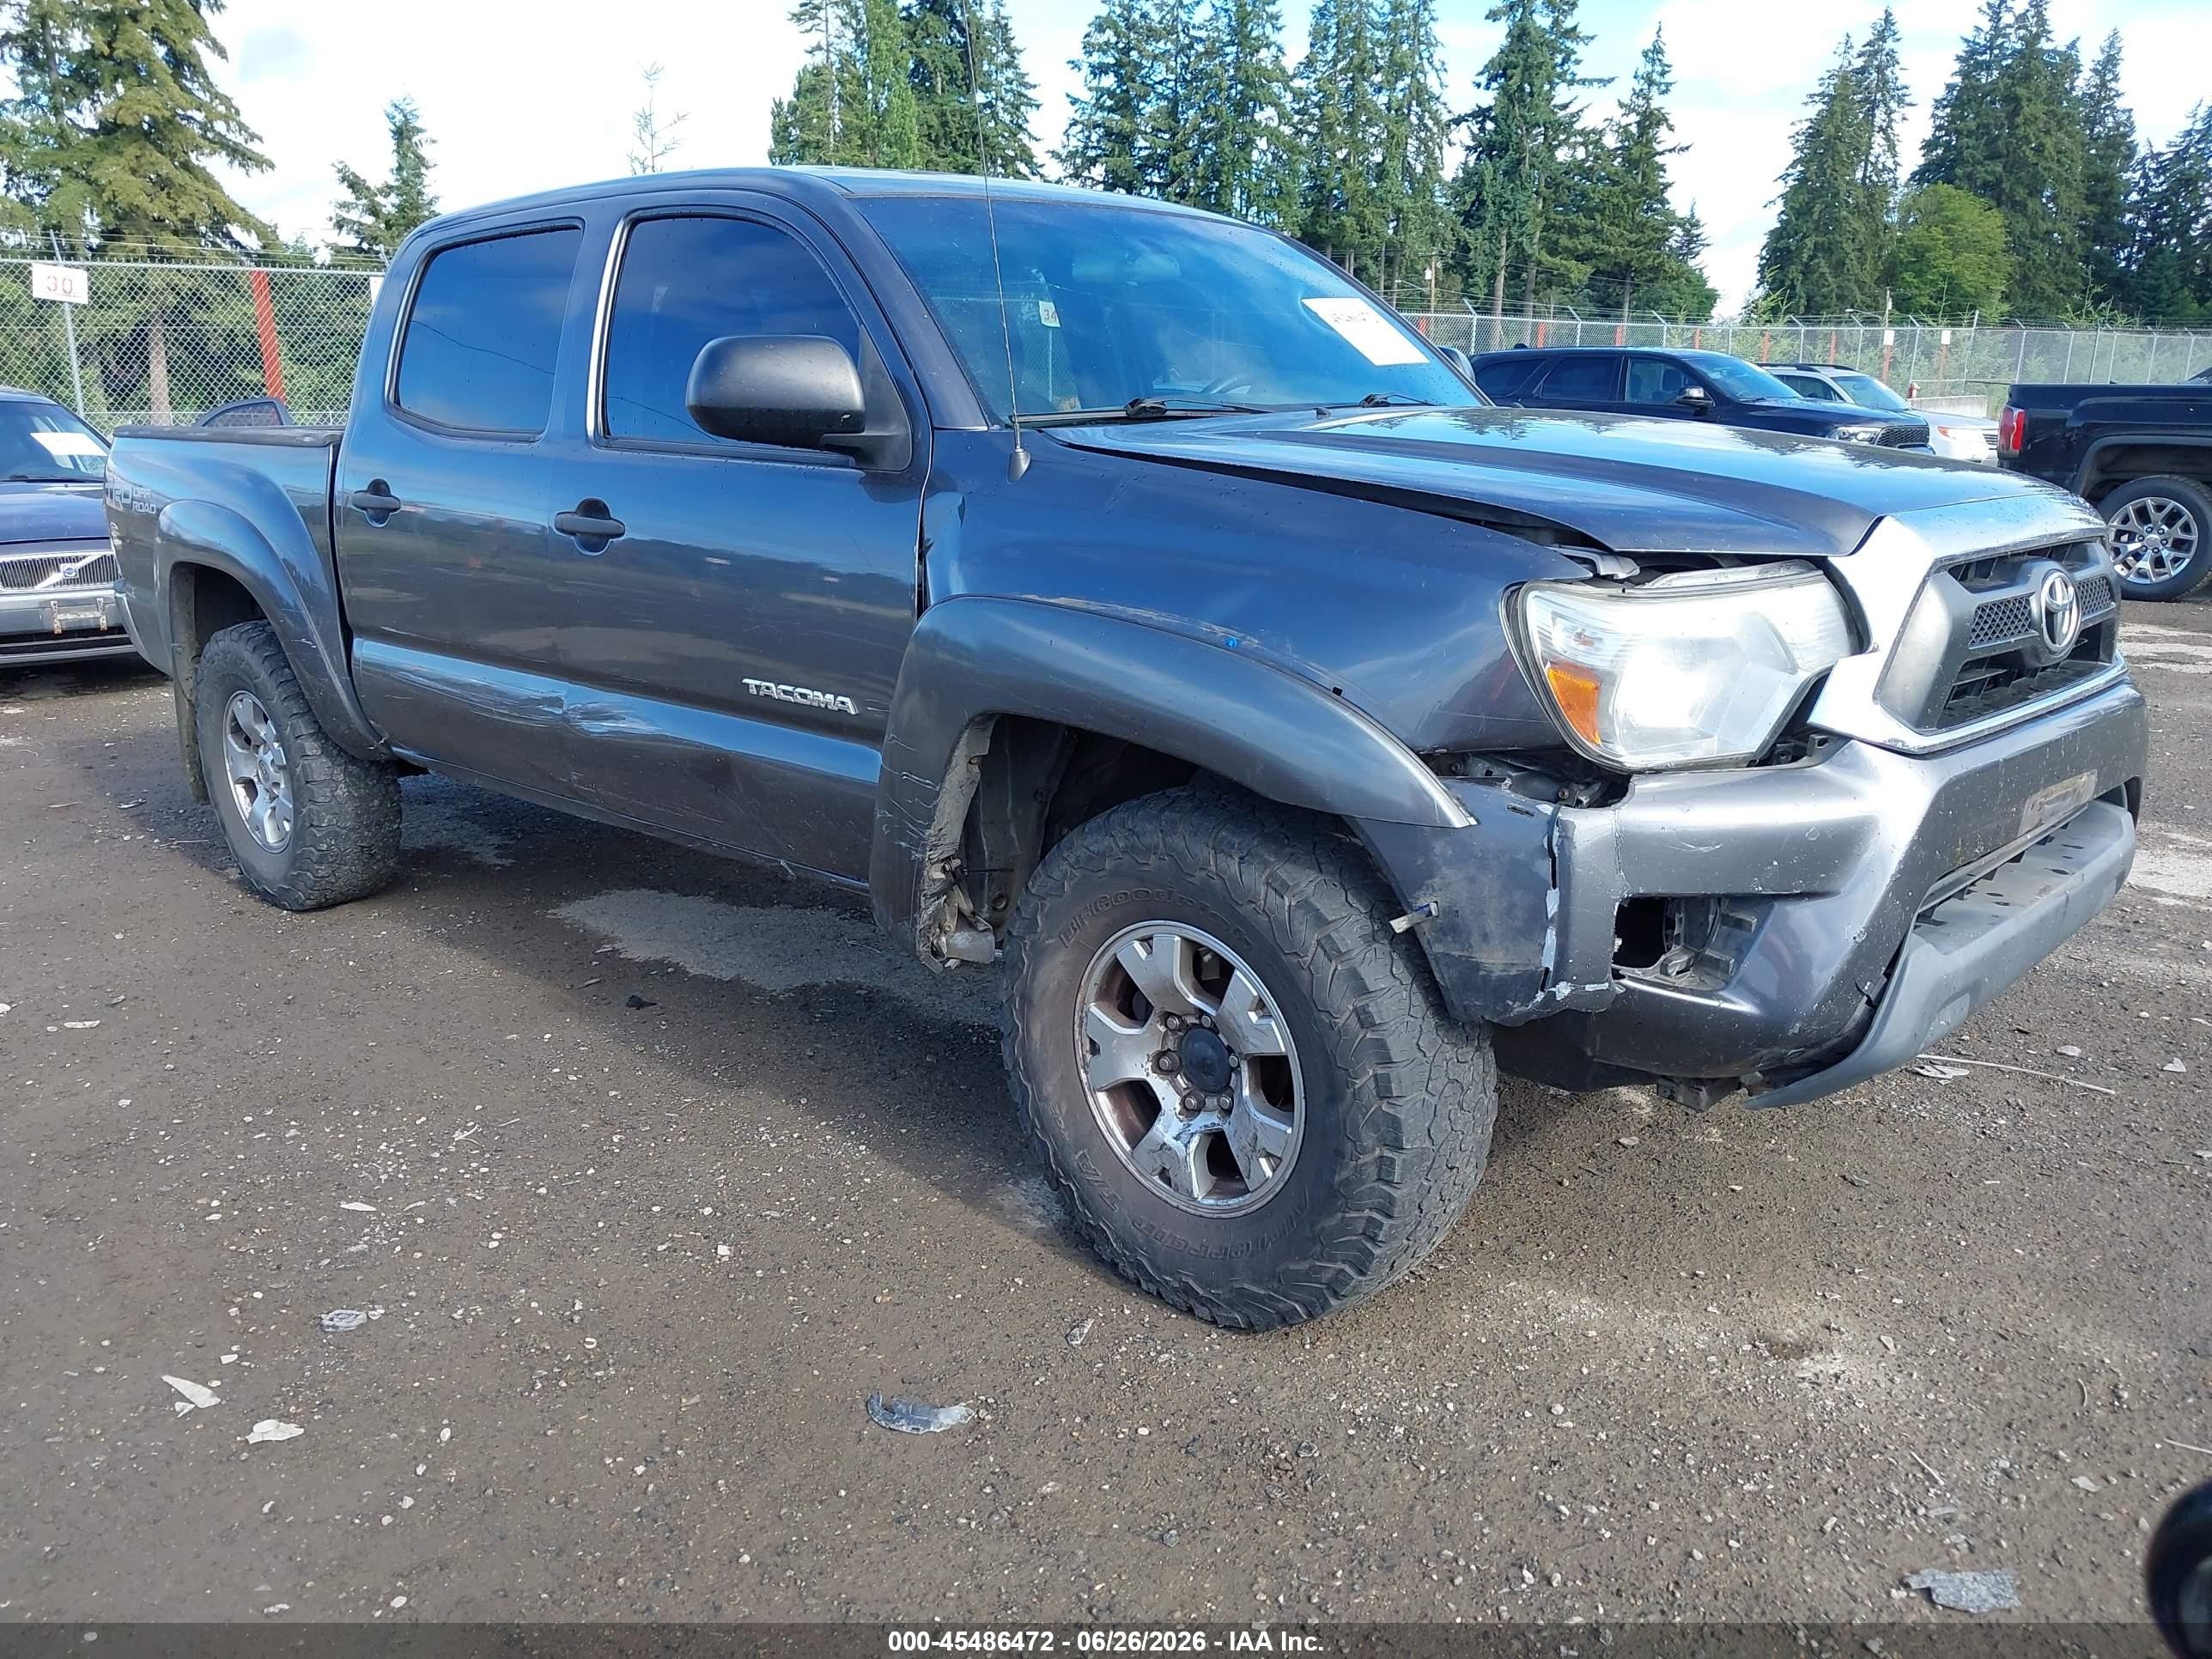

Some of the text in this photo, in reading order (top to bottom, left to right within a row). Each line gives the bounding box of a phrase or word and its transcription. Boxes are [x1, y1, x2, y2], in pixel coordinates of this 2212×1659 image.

[46, 275, 74, 295] 30
[132, 501, 156, 514] ROAD
[741, 678, 860, 715] TACOMA
